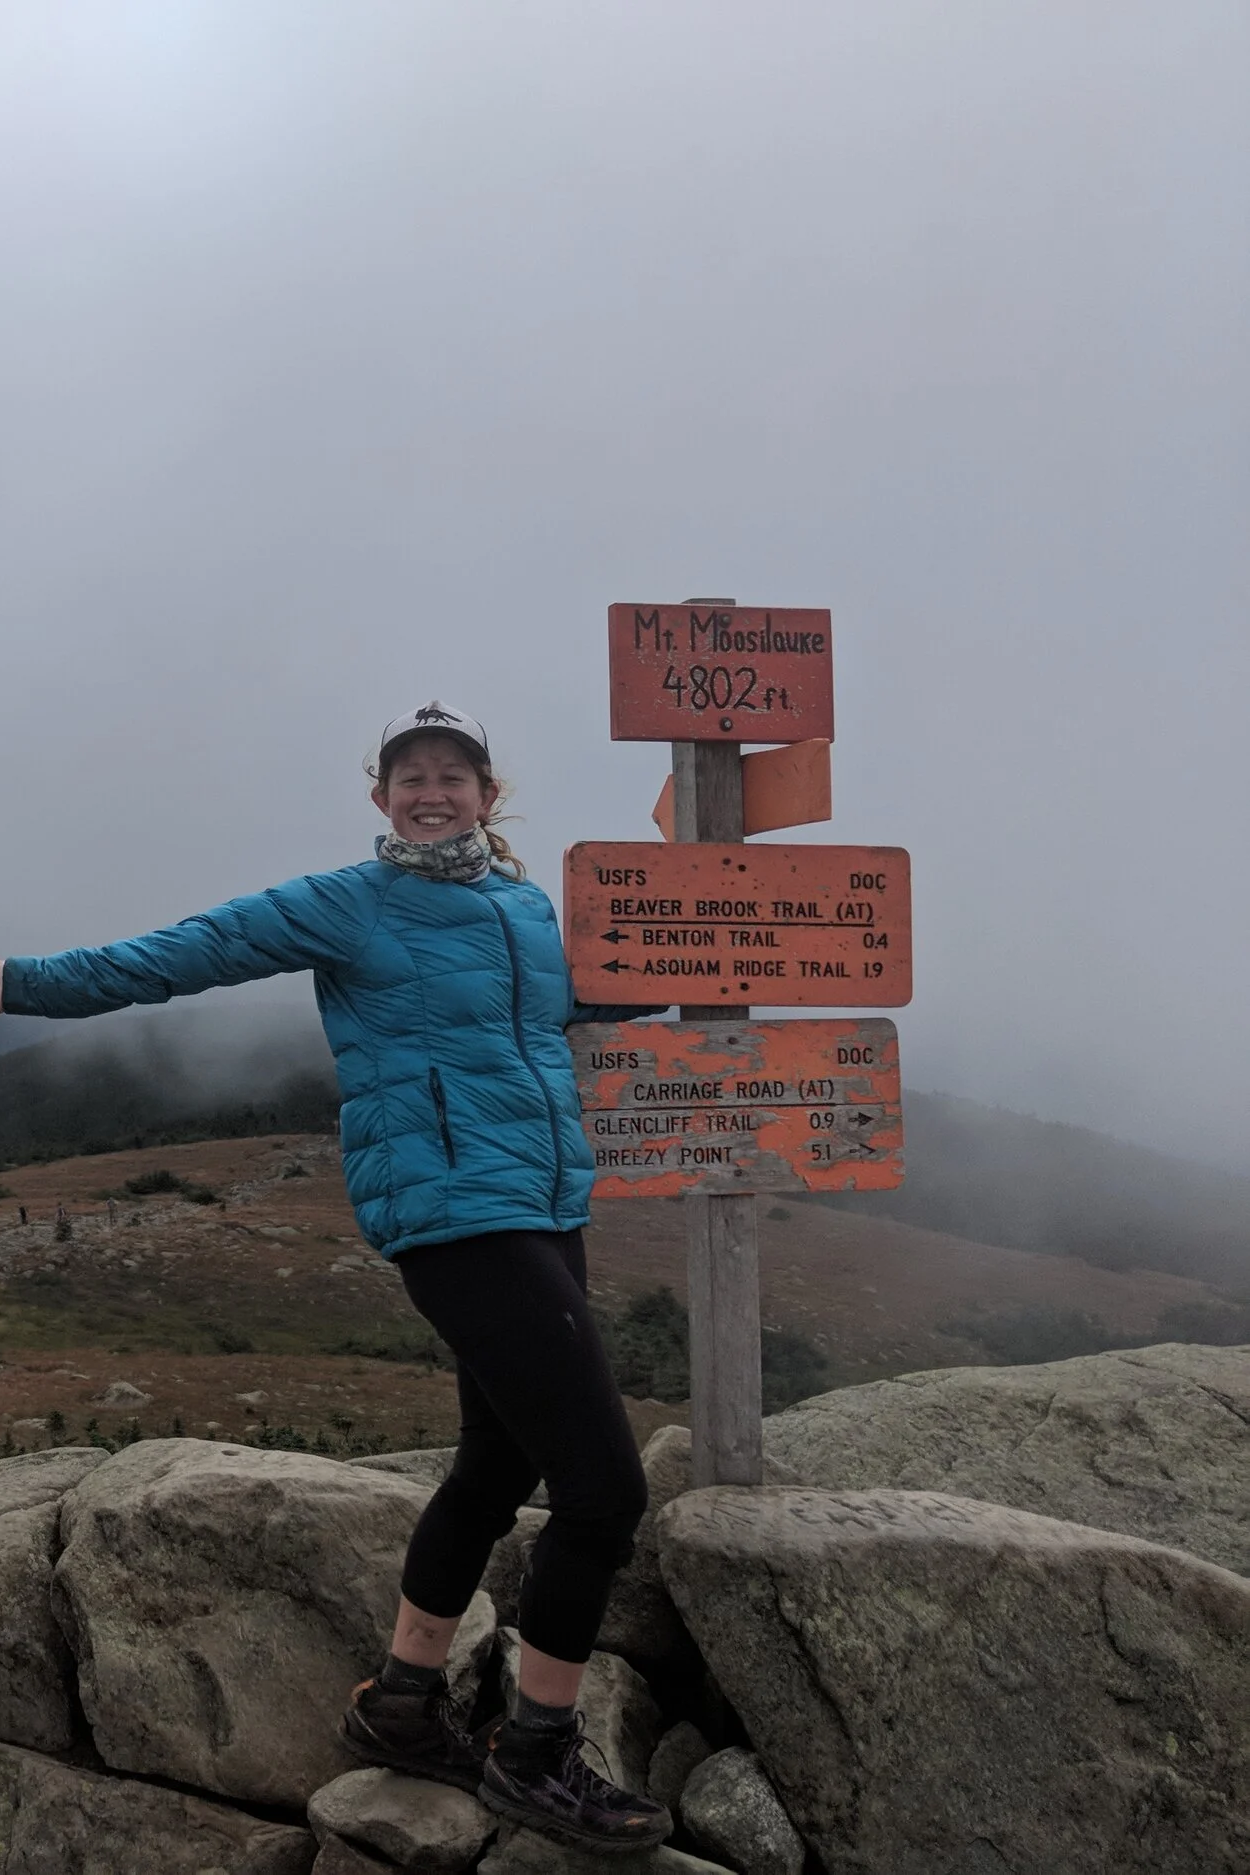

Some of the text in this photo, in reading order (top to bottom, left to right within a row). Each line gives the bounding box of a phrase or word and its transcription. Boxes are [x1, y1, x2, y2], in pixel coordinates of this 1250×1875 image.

[634, 609, 678, 650] Mt.
[662, 665, 793, 710] 4802 ft.
[598, 869, 646, 886] USFS
[850, 873, 886, 889] DOC
[611, 899, 874, 921] BEAVER BROOK TRAIL (AT)
[643, 929, 888, 949] BENTON TRAIL 0.4
[643, 960, 883, 978] ASQUAM RIDGE TRAIL 1.9
[592, 1052, 639, 1070] USFS
[837, 1048, 874, 1065] DOC
[634, 1080, 834, 1101] CARRIAGE ROAD (AT)
[595, 1112, 834, 1135] GLENCLIFF TRAIL 0.9
[595, 1144, 831, 1166] BREEZY POINT 5.1
